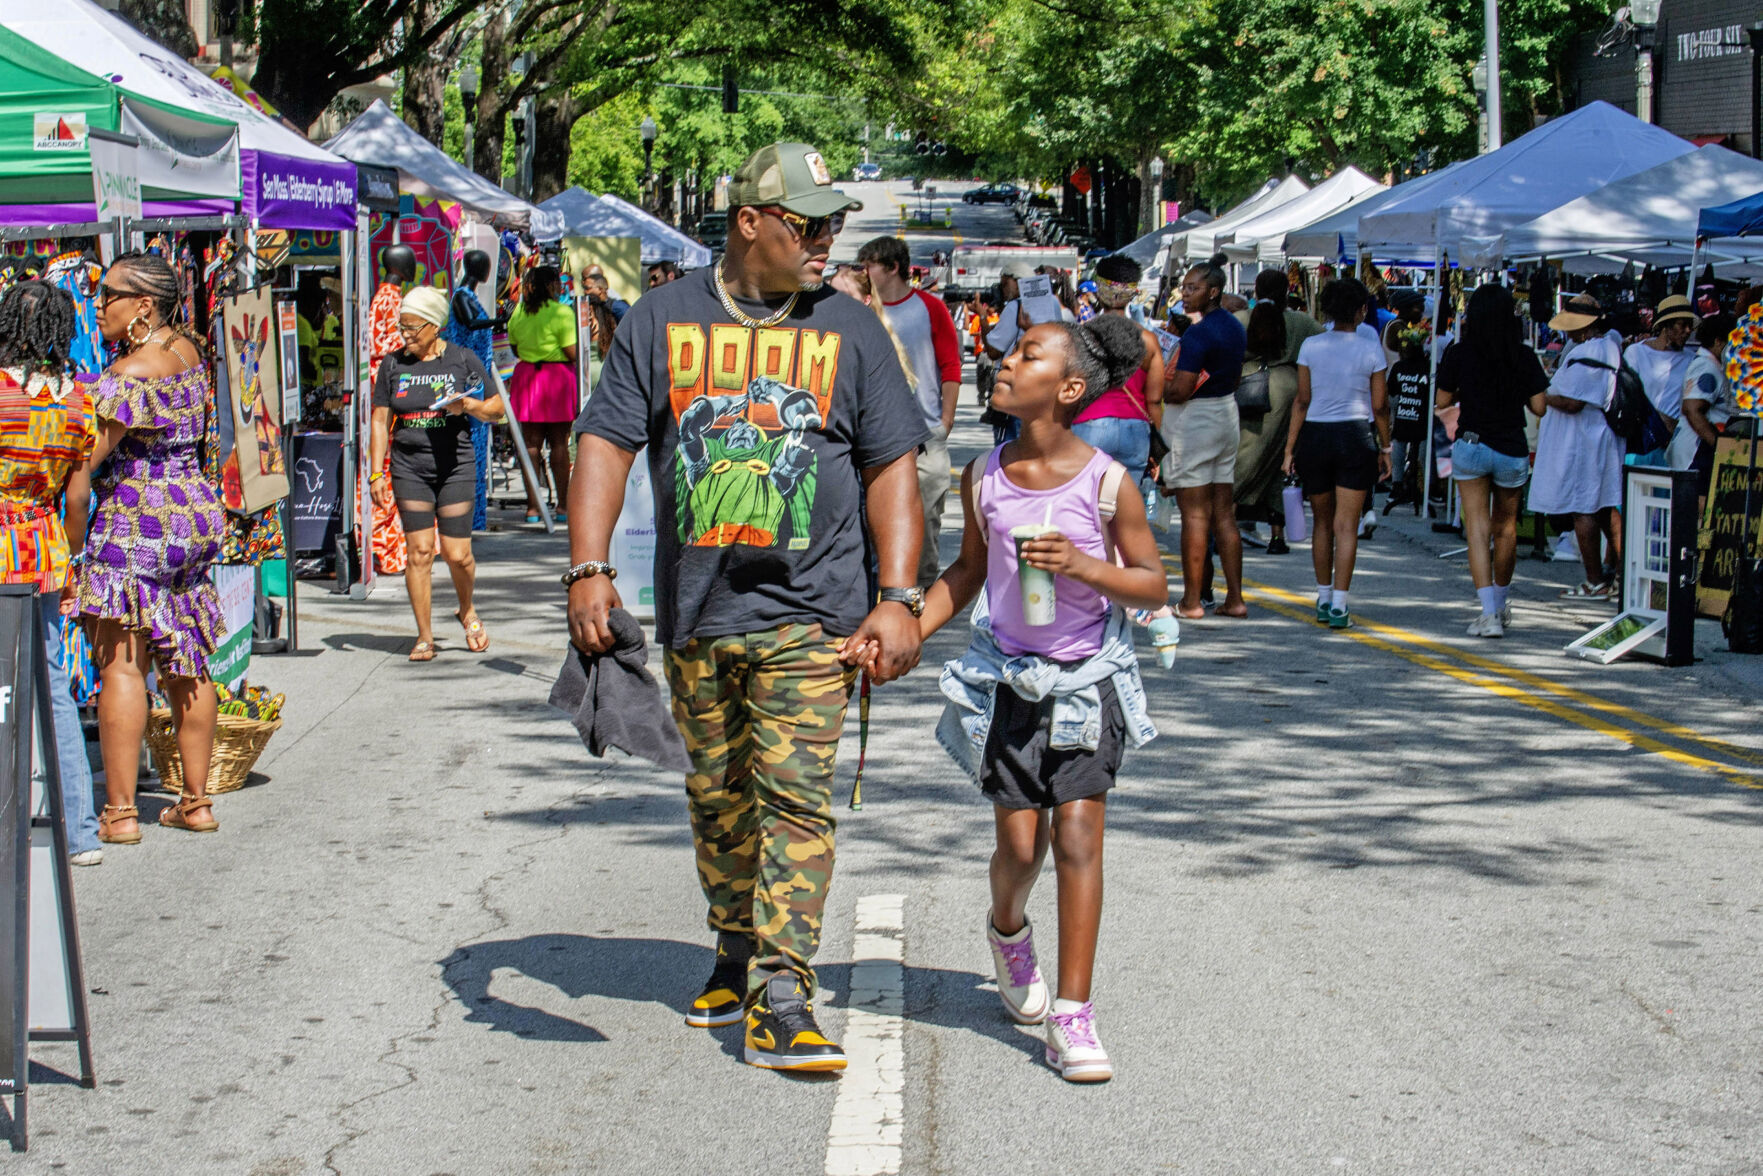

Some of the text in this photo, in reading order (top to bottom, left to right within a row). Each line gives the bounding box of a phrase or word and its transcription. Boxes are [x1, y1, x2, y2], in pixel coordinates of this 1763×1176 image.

[273, 173, 288, 200] Moss
[290, 174, 318, 208] Elderberry
[317, 177, 333, 209] Syrup
[339, 180, 354, 206] More
[667, 323, 841, 400] DOOM
[1402, 383, 1418, 394] Got
[1720, 470, 1763, 491] HENA
